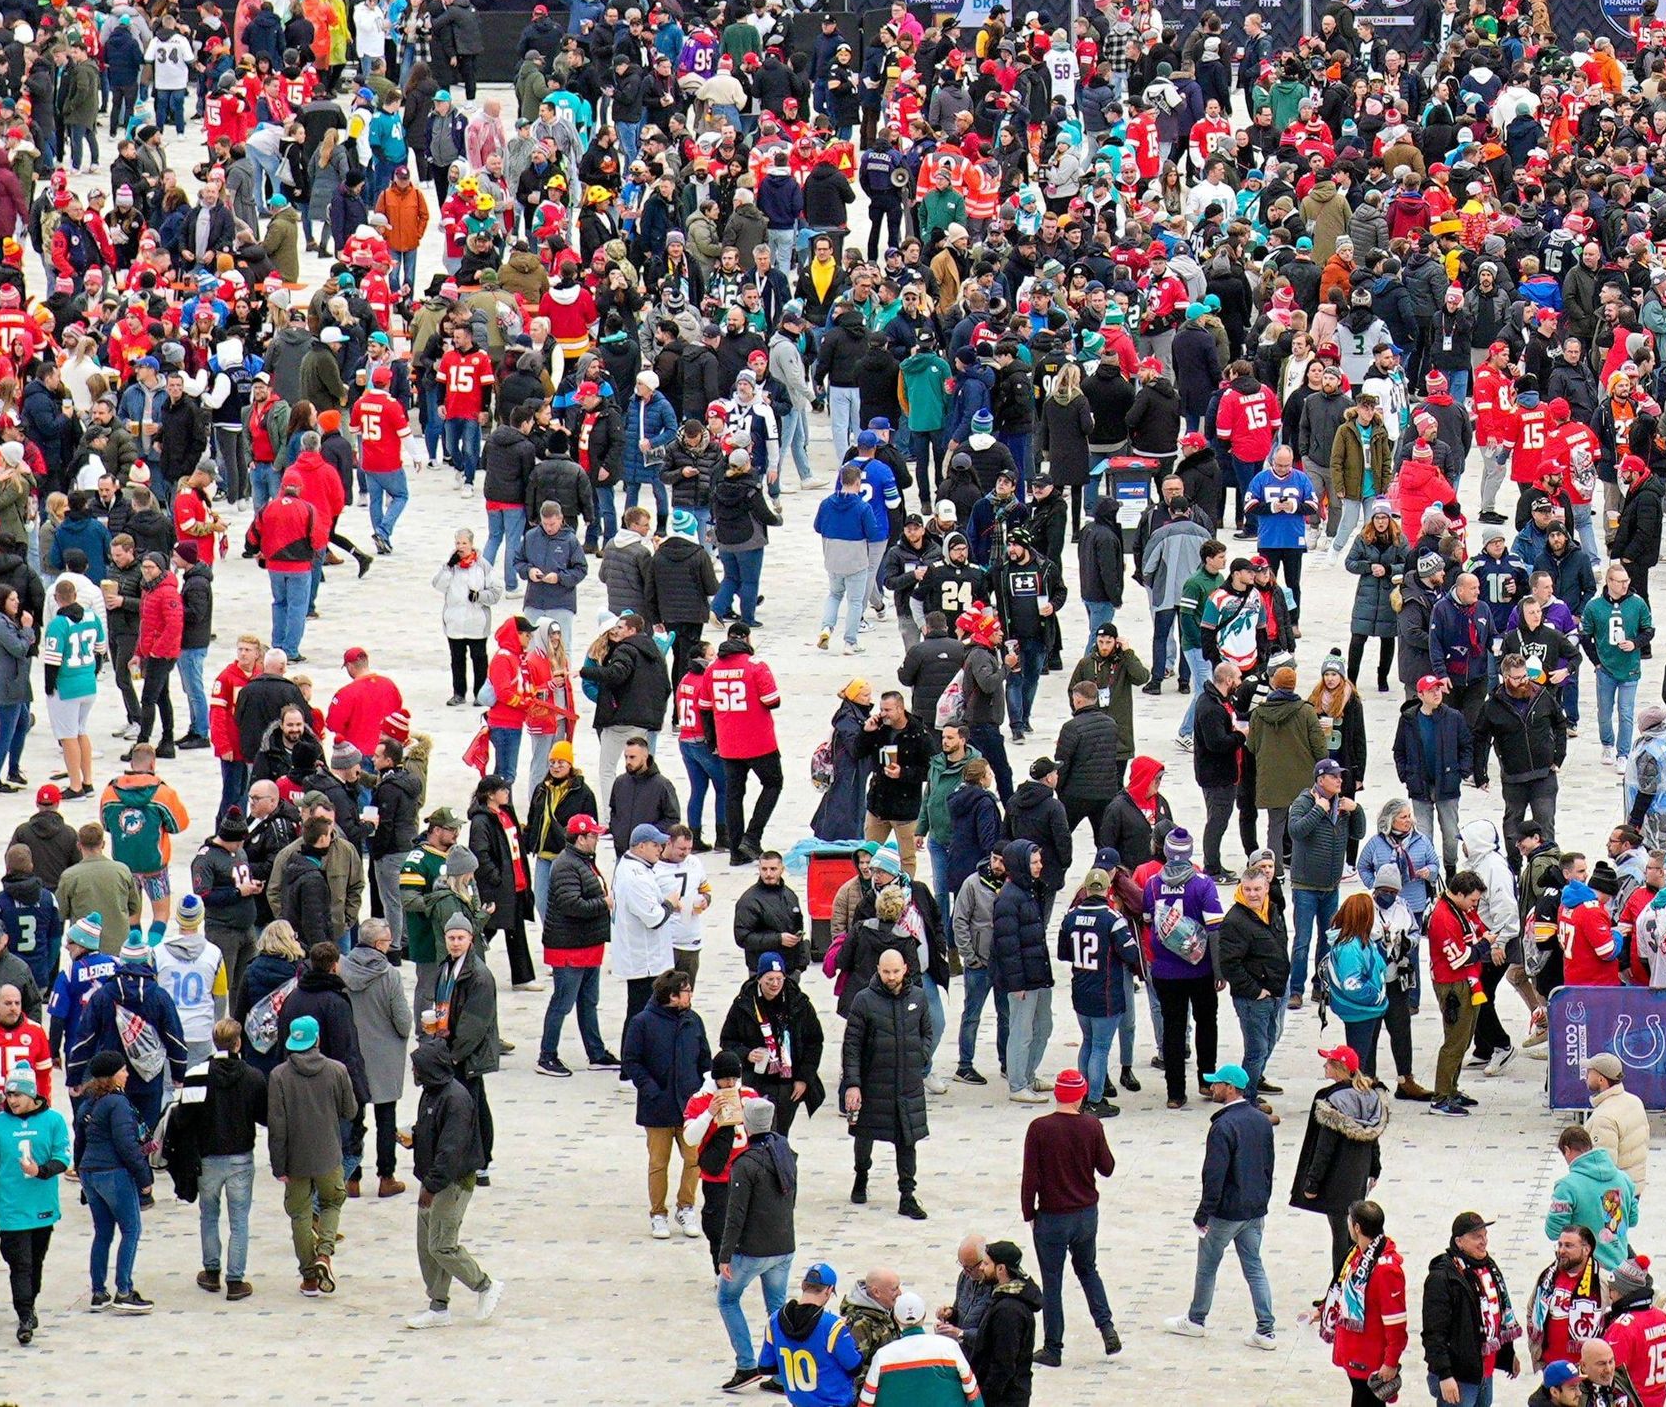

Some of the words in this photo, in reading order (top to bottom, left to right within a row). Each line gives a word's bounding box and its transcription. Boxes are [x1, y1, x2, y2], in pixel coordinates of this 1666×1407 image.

[157, 48, 179, 65] 34
[694, 49, 714, 71] 95
[1054, 64, 1071, 80] 58
[287, 84, 303, 106] 15
[207, 106, 221, 126] 15
[1543, 249, 1563, 274] 16
[1352, 335, 1364, 355] 3
[449, 365, 474, 393] 15
[361, 415, 381, 441] 15
[1245, 404, 1267, 430] 15
[1523, 422, 1544, 450] 15
[941, 581, 973, 612] 24
[1609, 616, 1623, 645] 6
[69, 629, 97, 667] 13
[714, 680, 747, 711] 52
[679, 698, 695, 727] 15
[674, 872, 687, 901] 7
[18, 916, 36, 951] 3
[1071, 931, 1099, 971] 12
[1442, 942, 1464, 962] 31
[78, 961, 115, 982] BLEDSOE
[173, 972, 203, 1007] 10
[779, 1347, 817, 1393] 10
